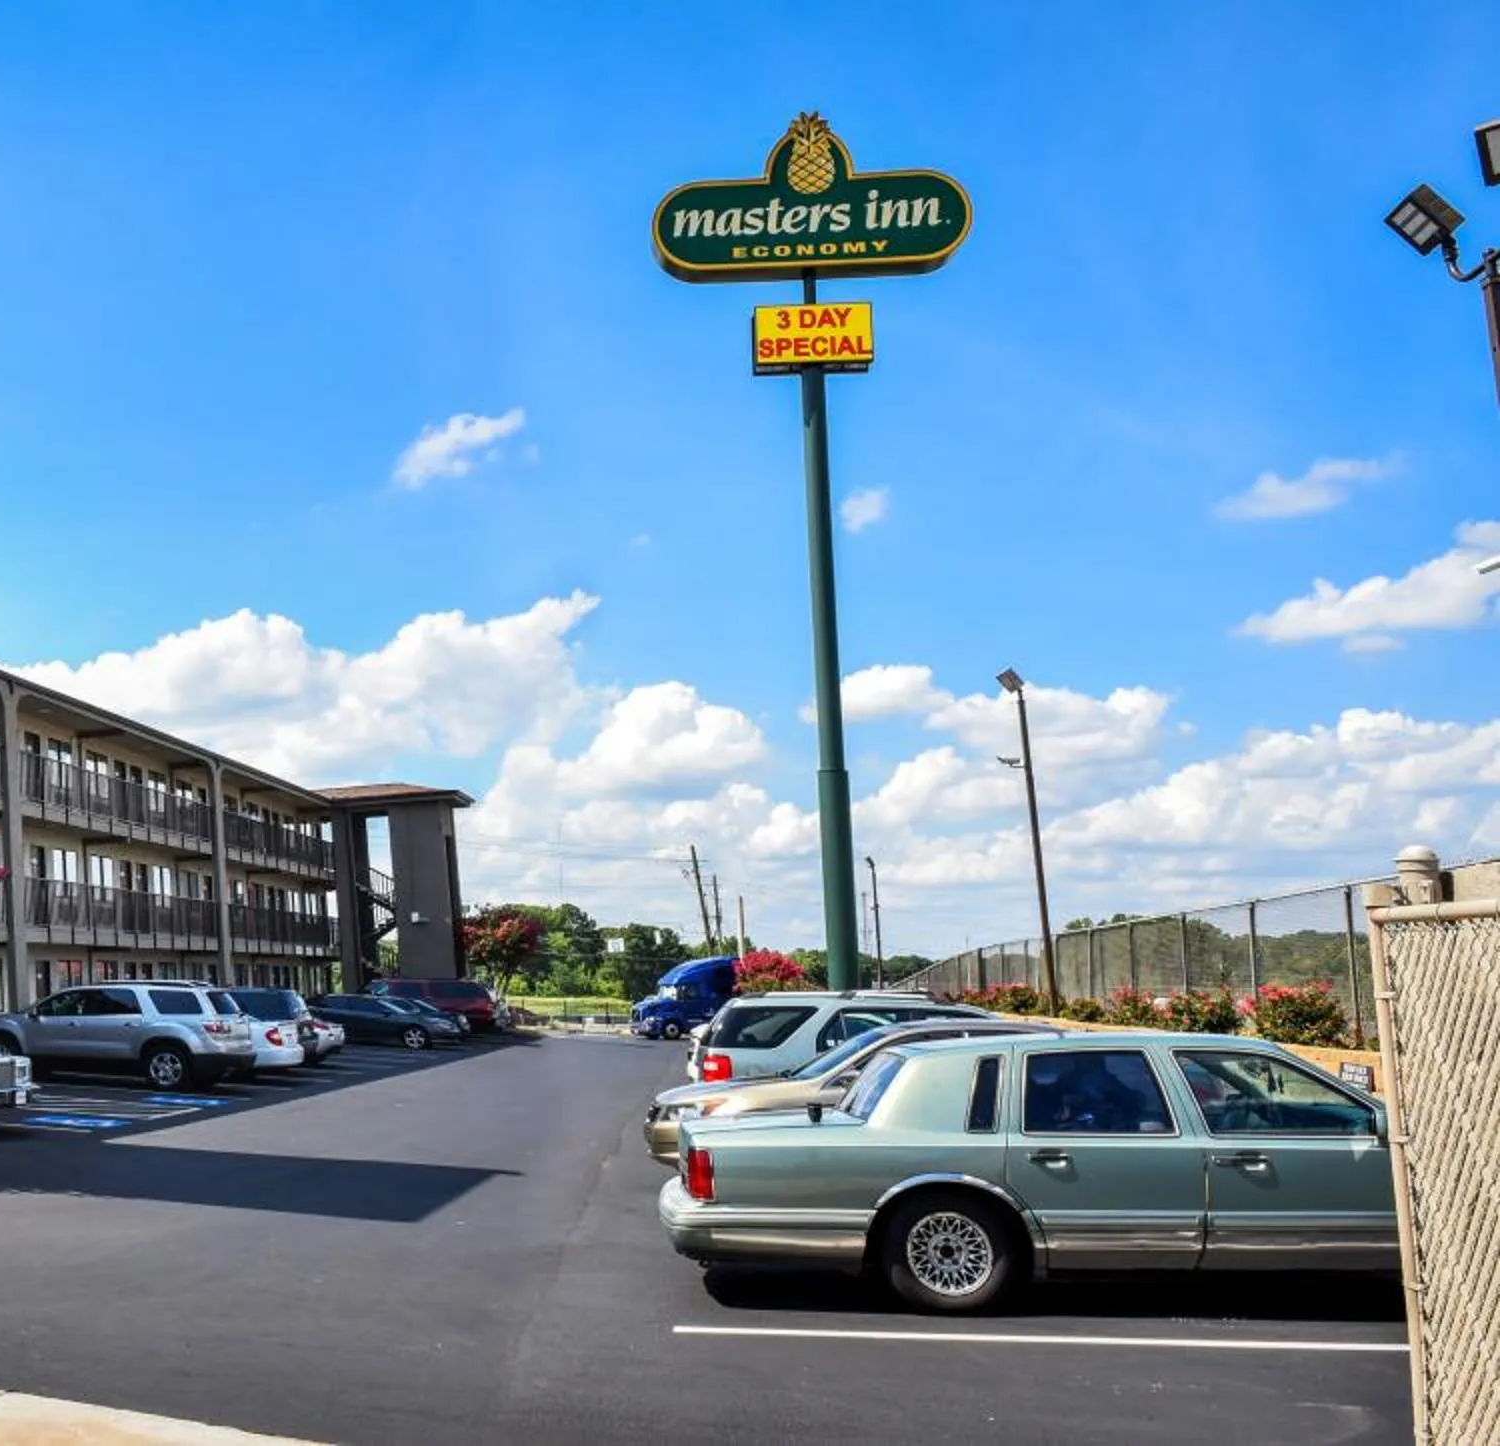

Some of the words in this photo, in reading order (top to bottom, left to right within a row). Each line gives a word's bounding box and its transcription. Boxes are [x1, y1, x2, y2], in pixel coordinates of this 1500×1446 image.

[673, 198, 851, 238] masters
[864, 189, 943, 230] inn
[731, 240, 888, 259] ECONOMY
[776, 310, 791, 330] 3
[799, 308, 852, 329] DAY
[759, 335, 873, 358] SPECIAL
